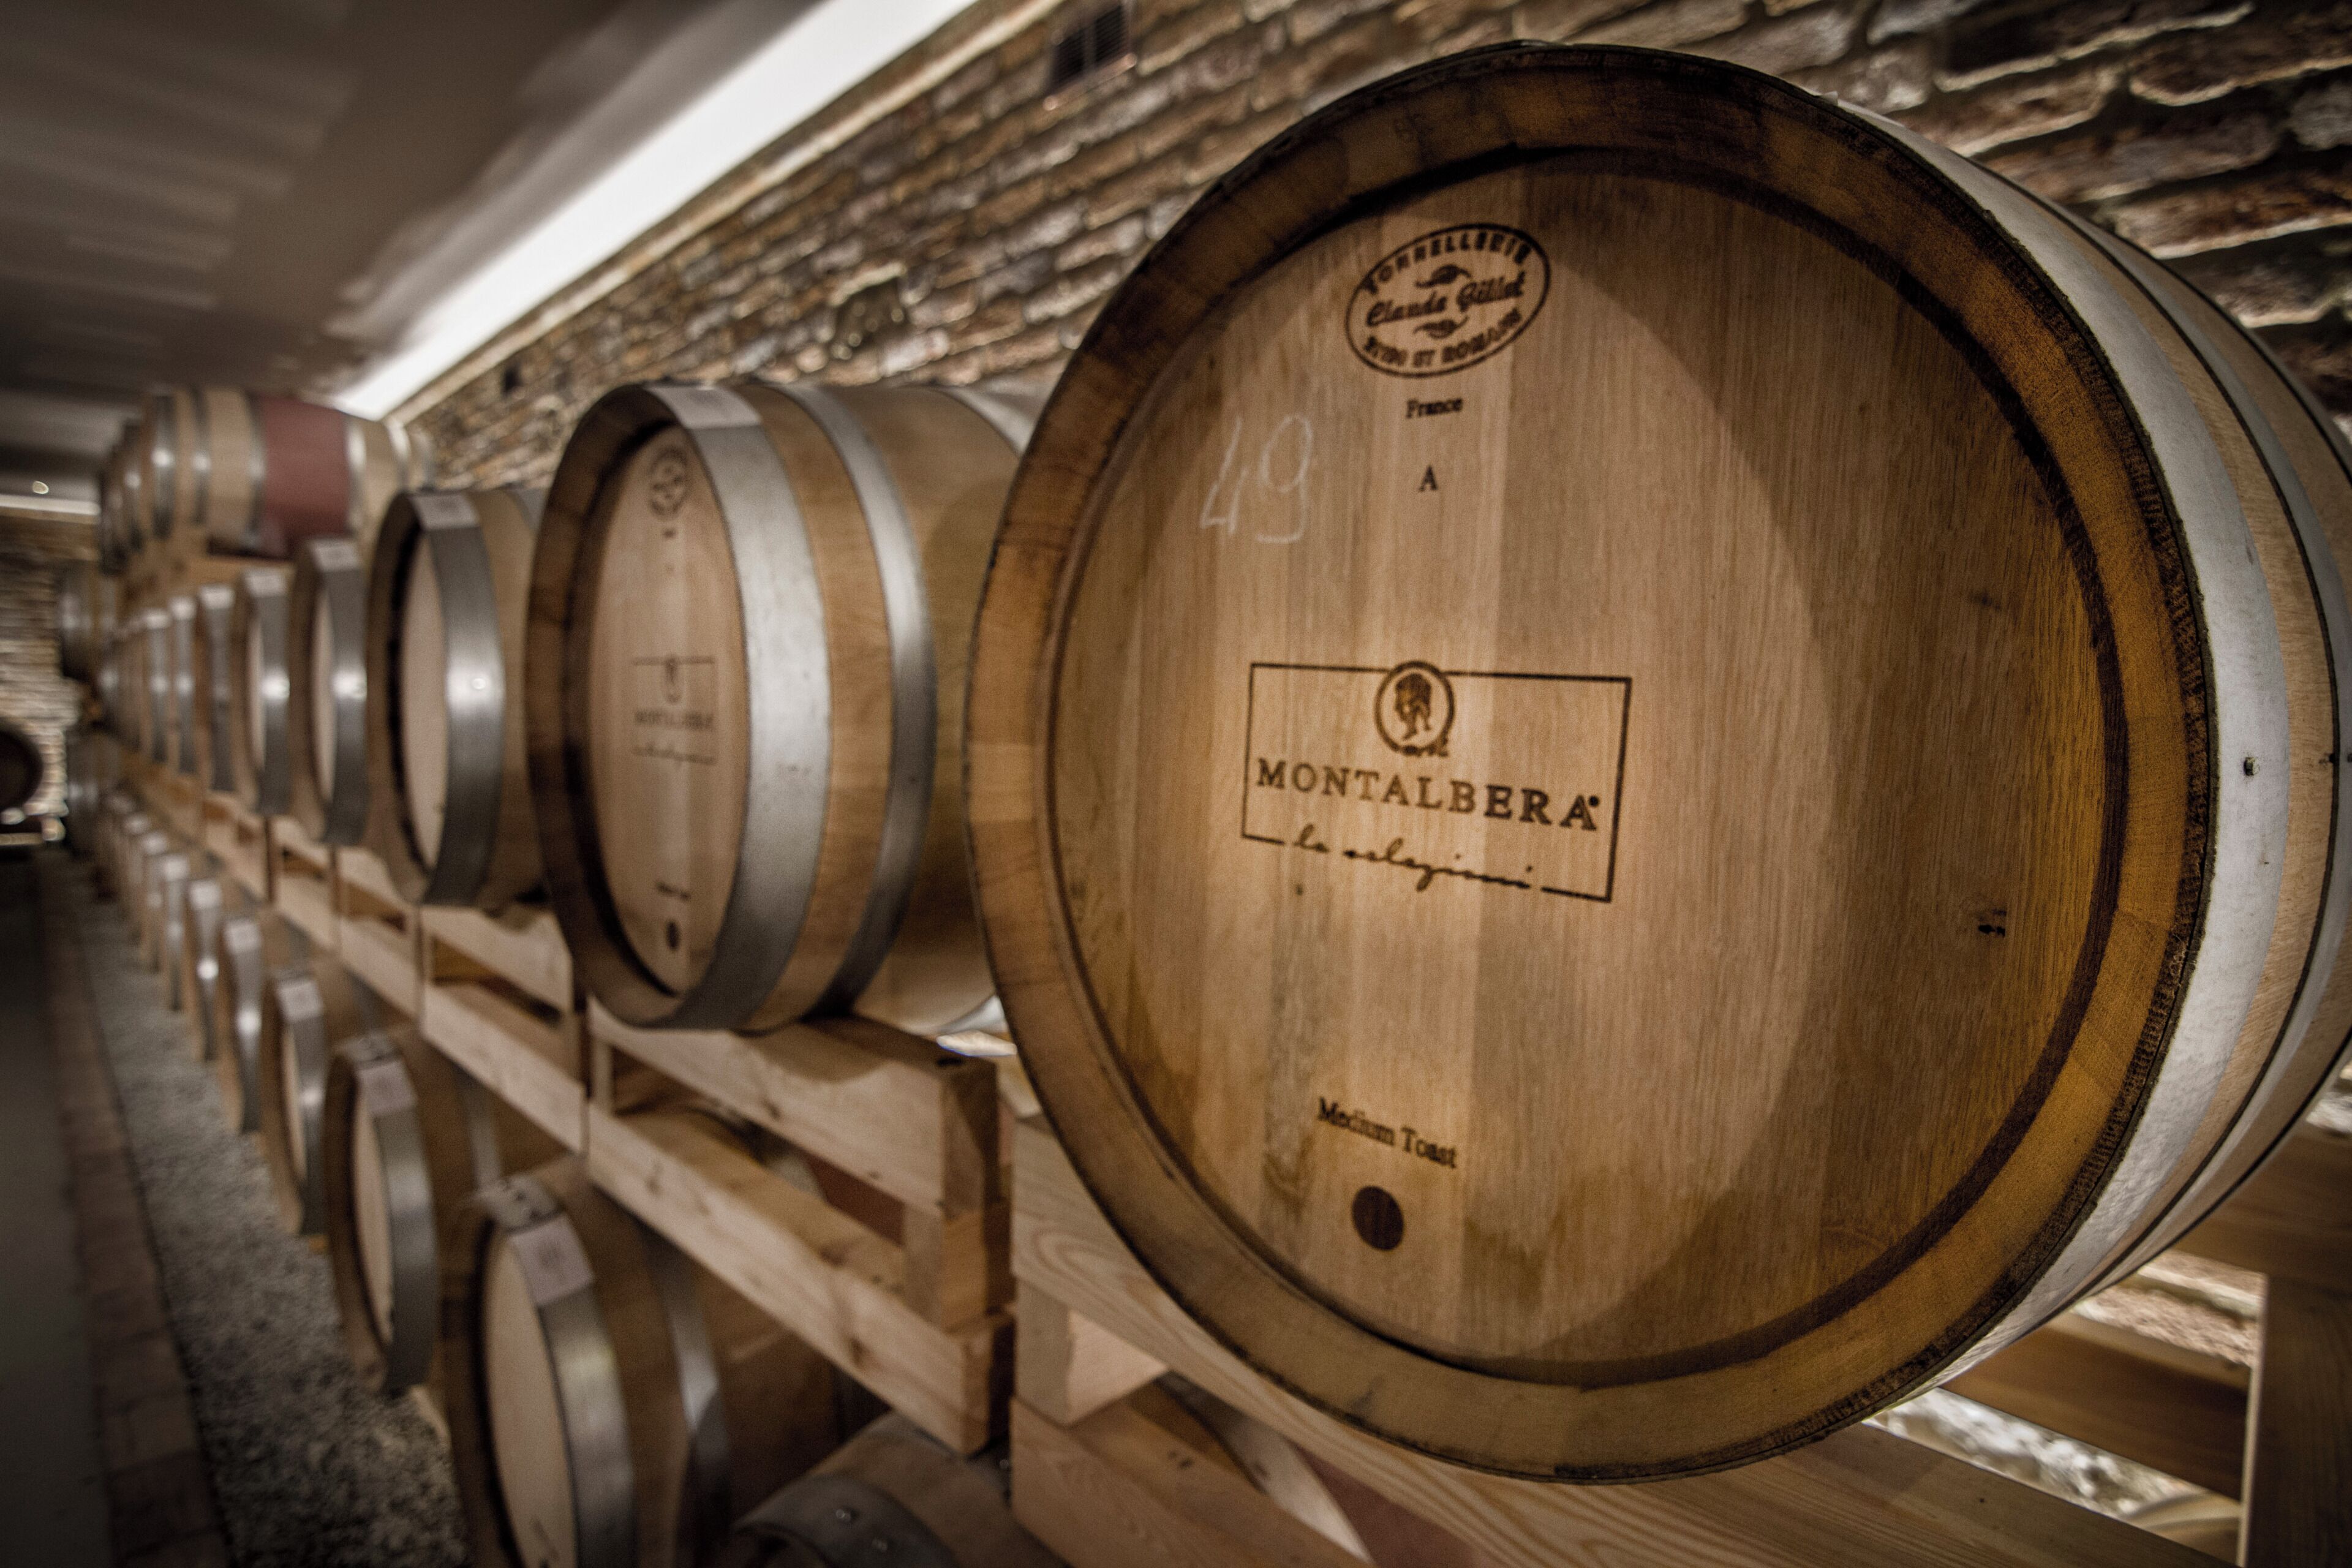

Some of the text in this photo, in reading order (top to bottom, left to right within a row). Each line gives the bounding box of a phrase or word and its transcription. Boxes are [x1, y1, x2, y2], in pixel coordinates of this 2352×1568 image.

[1366, 292, 1446, 327] Claude
[1406, 397, 1464, 419] France
[1200, 413, 1314, 543] 49
[1418, 466, 1438, 492] A
[1256, 758, 1598, 831] MONTALBERA
[1317, 1096, 1458, 1170] Medium Toast
